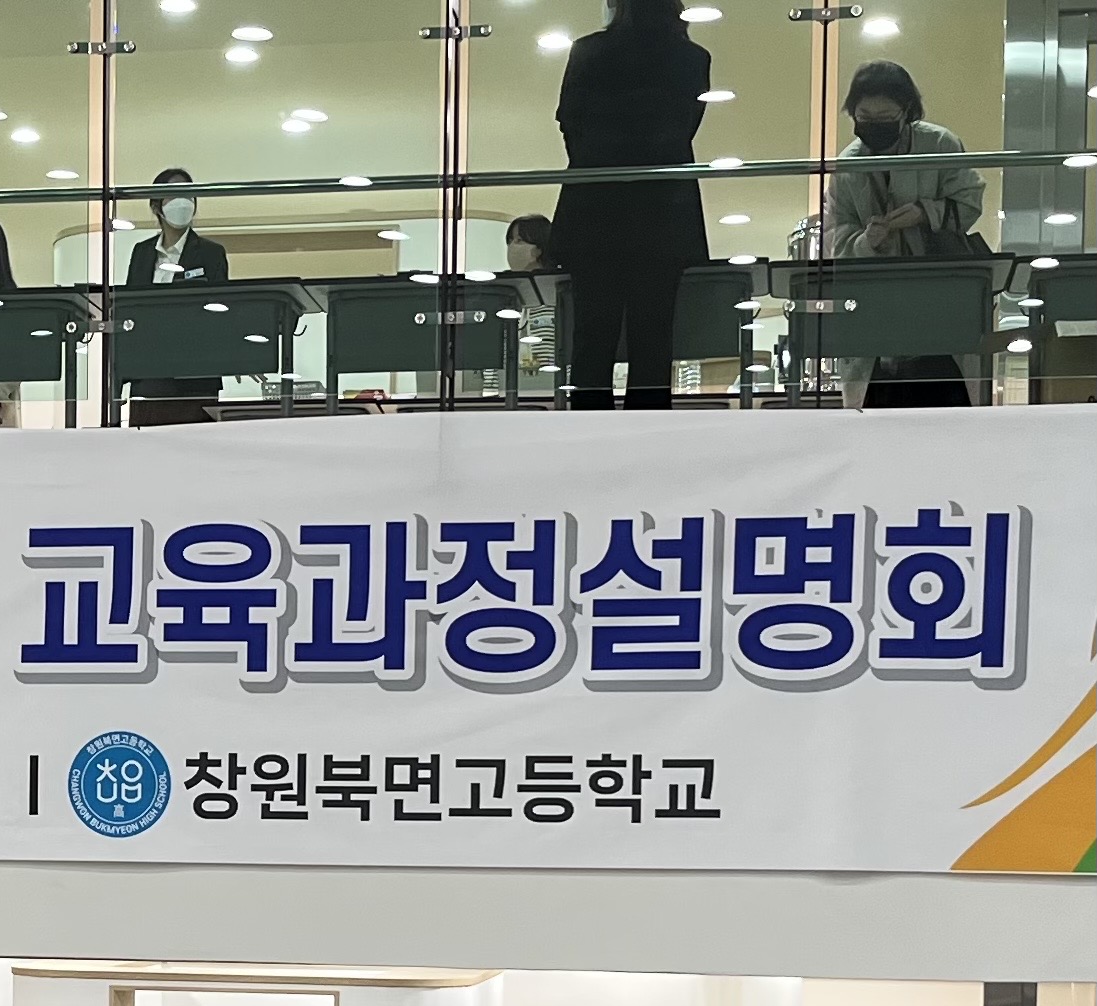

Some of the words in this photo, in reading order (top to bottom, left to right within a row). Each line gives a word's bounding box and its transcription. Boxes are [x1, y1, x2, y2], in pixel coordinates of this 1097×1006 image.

[20, 508, 1011, 674] 교육과정설명회
[70, 768, 92, 821] CHANGWON
[89, 817, 139, 835] BUKMYEON
[138, 808, 158, 828] HIGH
[154, 771, 167, 809] SCHOOL
[183, 751, 722, 825] 창원북면고등학교
